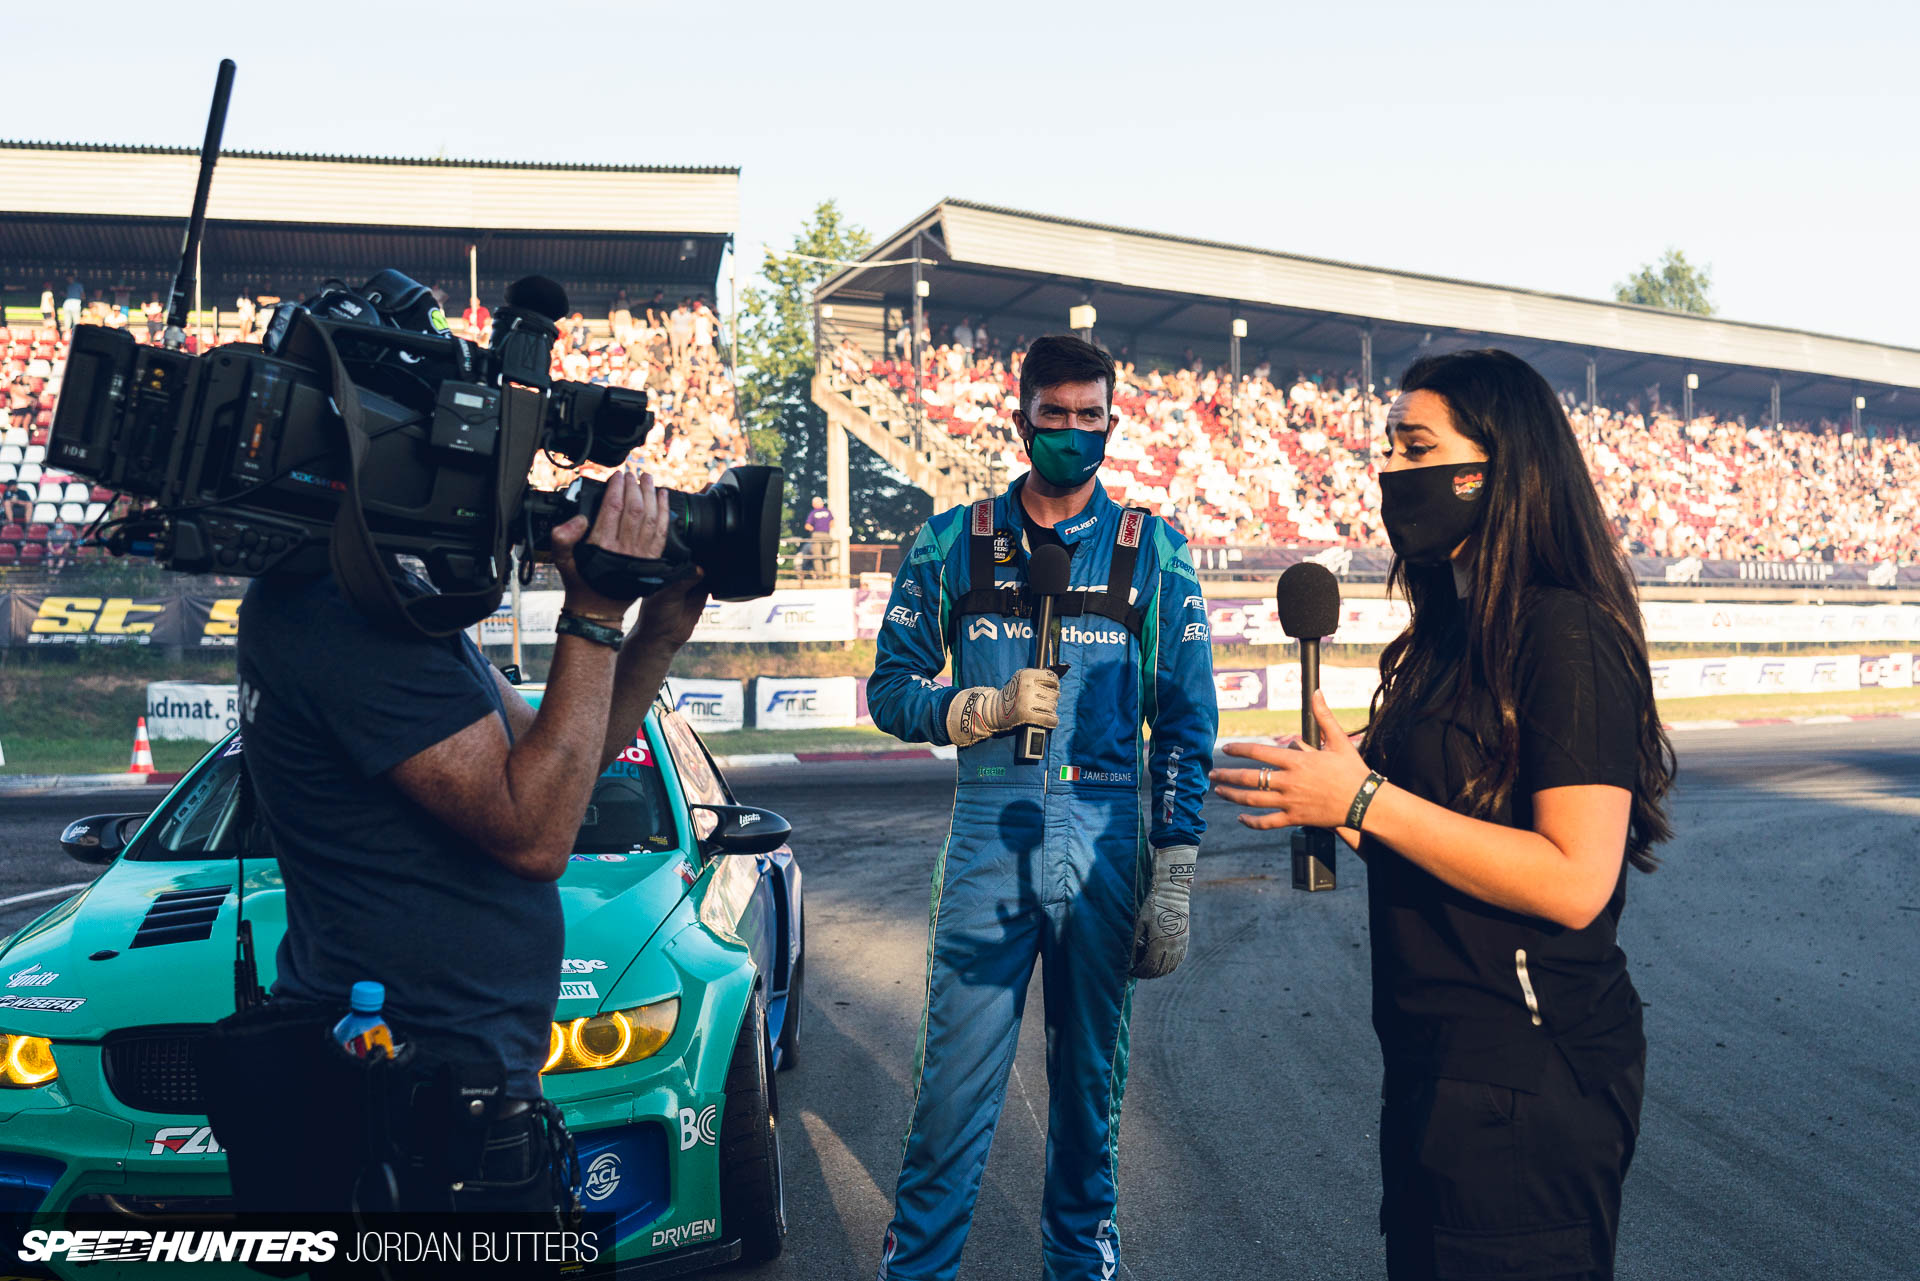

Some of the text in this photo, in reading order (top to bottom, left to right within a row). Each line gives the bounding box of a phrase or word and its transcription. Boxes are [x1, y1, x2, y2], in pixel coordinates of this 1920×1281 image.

[978, 502, 988, 533] SIMPSON
[1064, 516, 1098, 535] FALKEN
[1123, 513, 1139, 545] SIMPSON
[994, 537, 1008, 547] rift
[765, 603, 816, 624] FMIC
[889, 605, 923, 624] ECU
[674, 693, 723, 716] FMIC
[766, 690, 817, 712] FMIC
[961, 691, 979, 734] sparco
[1083, 771, 1132, 782] JAMES DEANE
[1162, 745, 1184, 825] FALKEN
[561, 958, 608, 974] rge
[679, 1104, 717, 1151] BC
[146, 1126, 227, 1155] FA
[586, 1168, 621, 1189] ACL
[651, 1218, 717, 1248] DRIVEN
